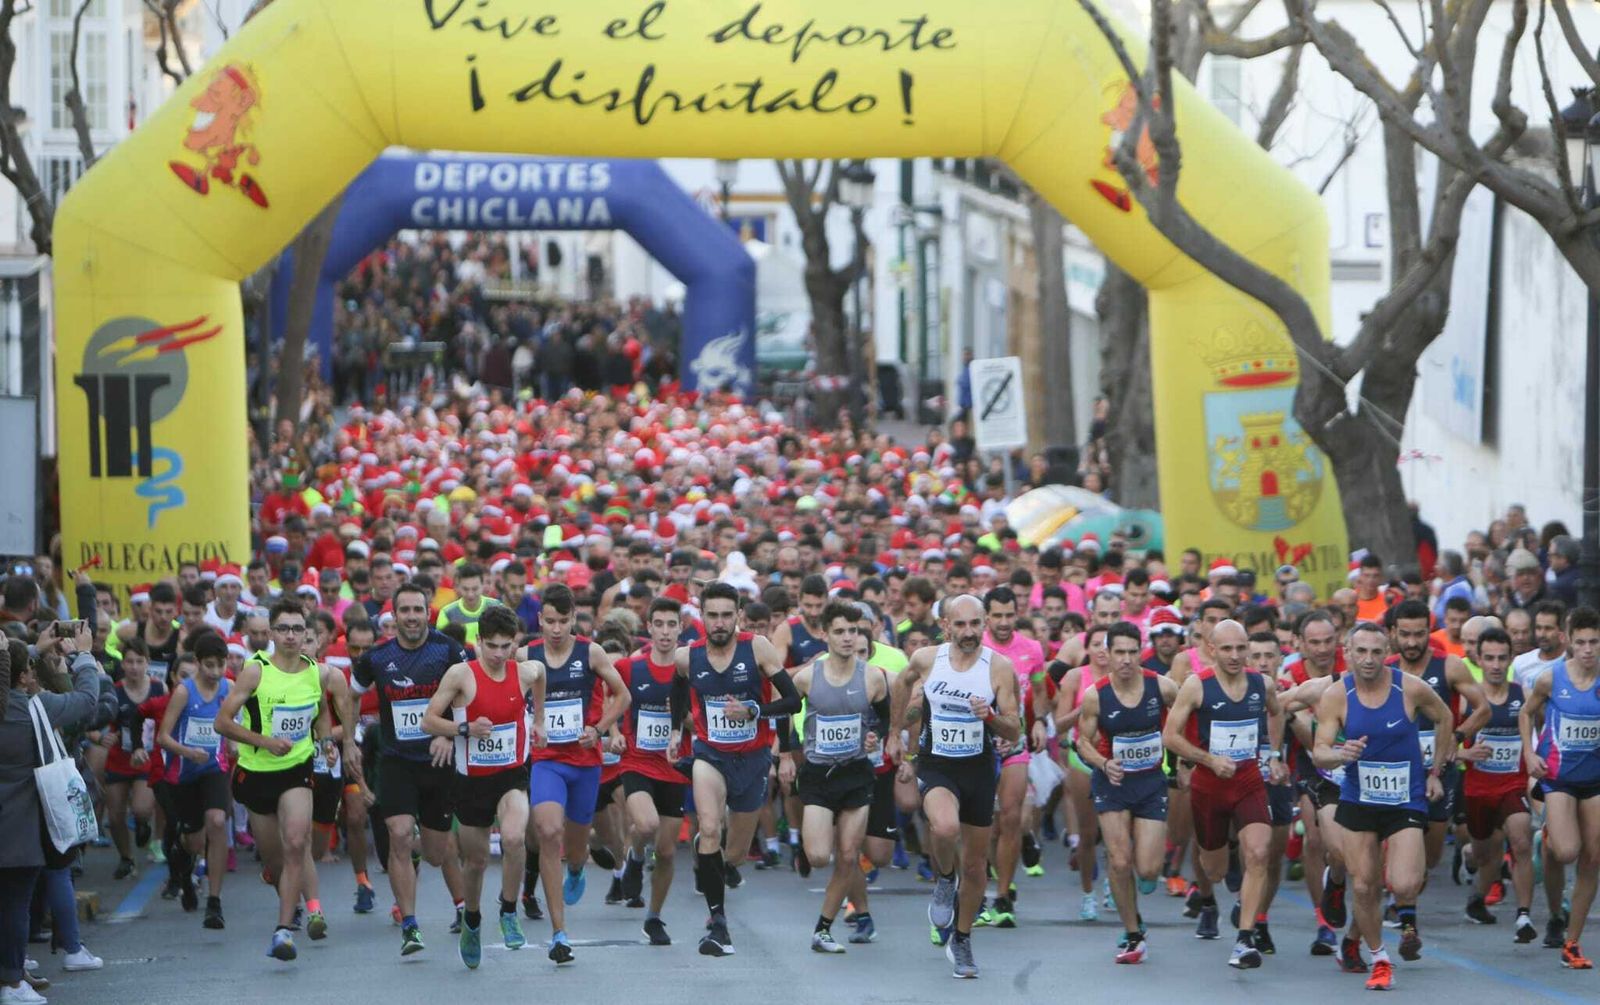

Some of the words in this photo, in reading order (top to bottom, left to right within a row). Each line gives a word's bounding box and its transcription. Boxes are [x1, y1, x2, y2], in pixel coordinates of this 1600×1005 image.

[423, 0, 561, 39] Vive
[602, 1, 667, 40] el
[707, 3, 957, 63] deporte
[414, 162, 612, 191] DEPORTES
[411, 197, 612, 223] CHICLANA
[281, 718, 304, 732] 695
[549, 714, 565, 728] 74
[712, 714, 745, 729] 1169
[647, 724, 670, 737] 198
[820, 727, 851, 741] 1062
[941, 728, 966, 742] 971
[1566, 726, 1598, 739] 1109
[478, 738, 503, 752] 694
[1229, 734, 1237, 747] 7
[1119, 746, 1151, 759] 1068
[1364, 775, 1397, 790] 1011
